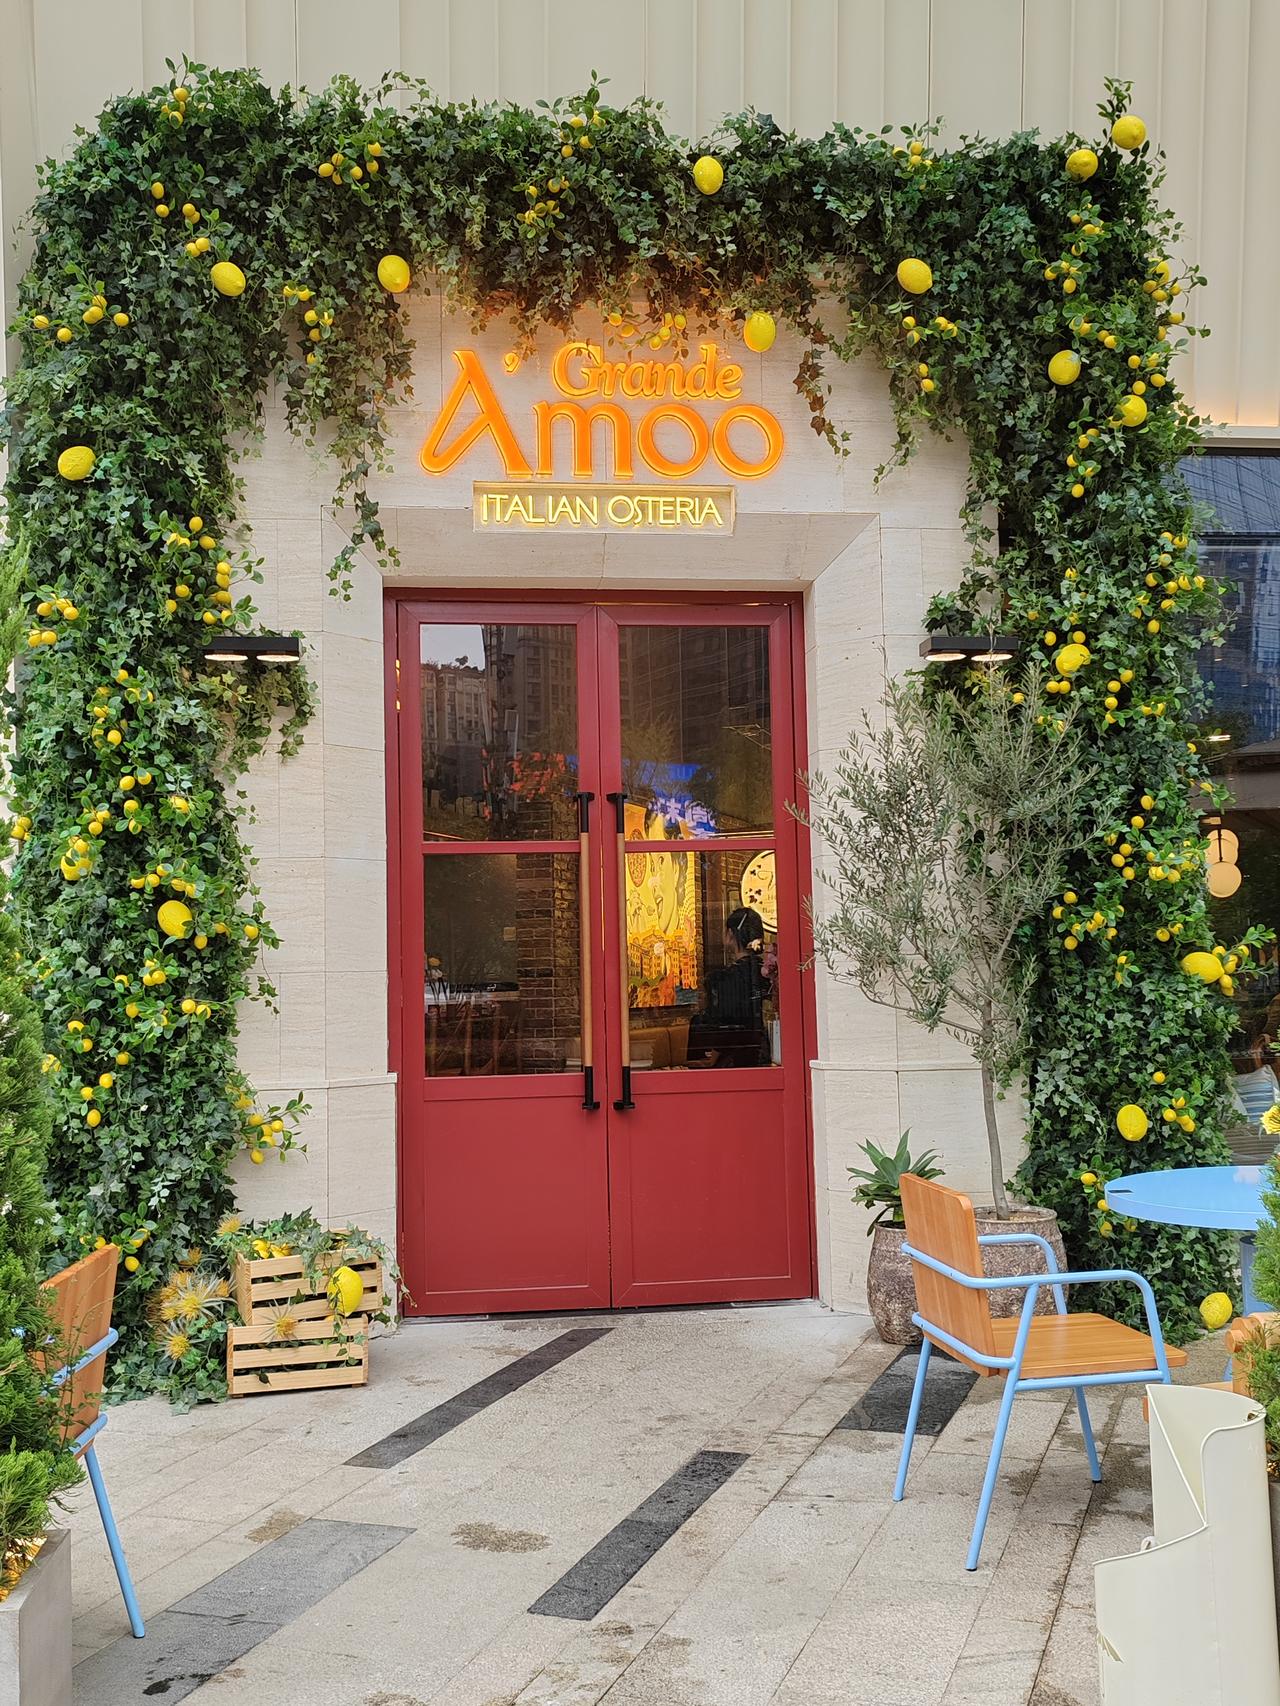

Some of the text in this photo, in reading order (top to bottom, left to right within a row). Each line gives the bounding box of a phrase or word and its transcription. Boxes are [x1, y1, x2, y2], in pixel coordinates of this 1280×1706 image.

[553, 342, 742, 399] Grande
[480, 493, 723, 525] ITALIAN OSTERIA
